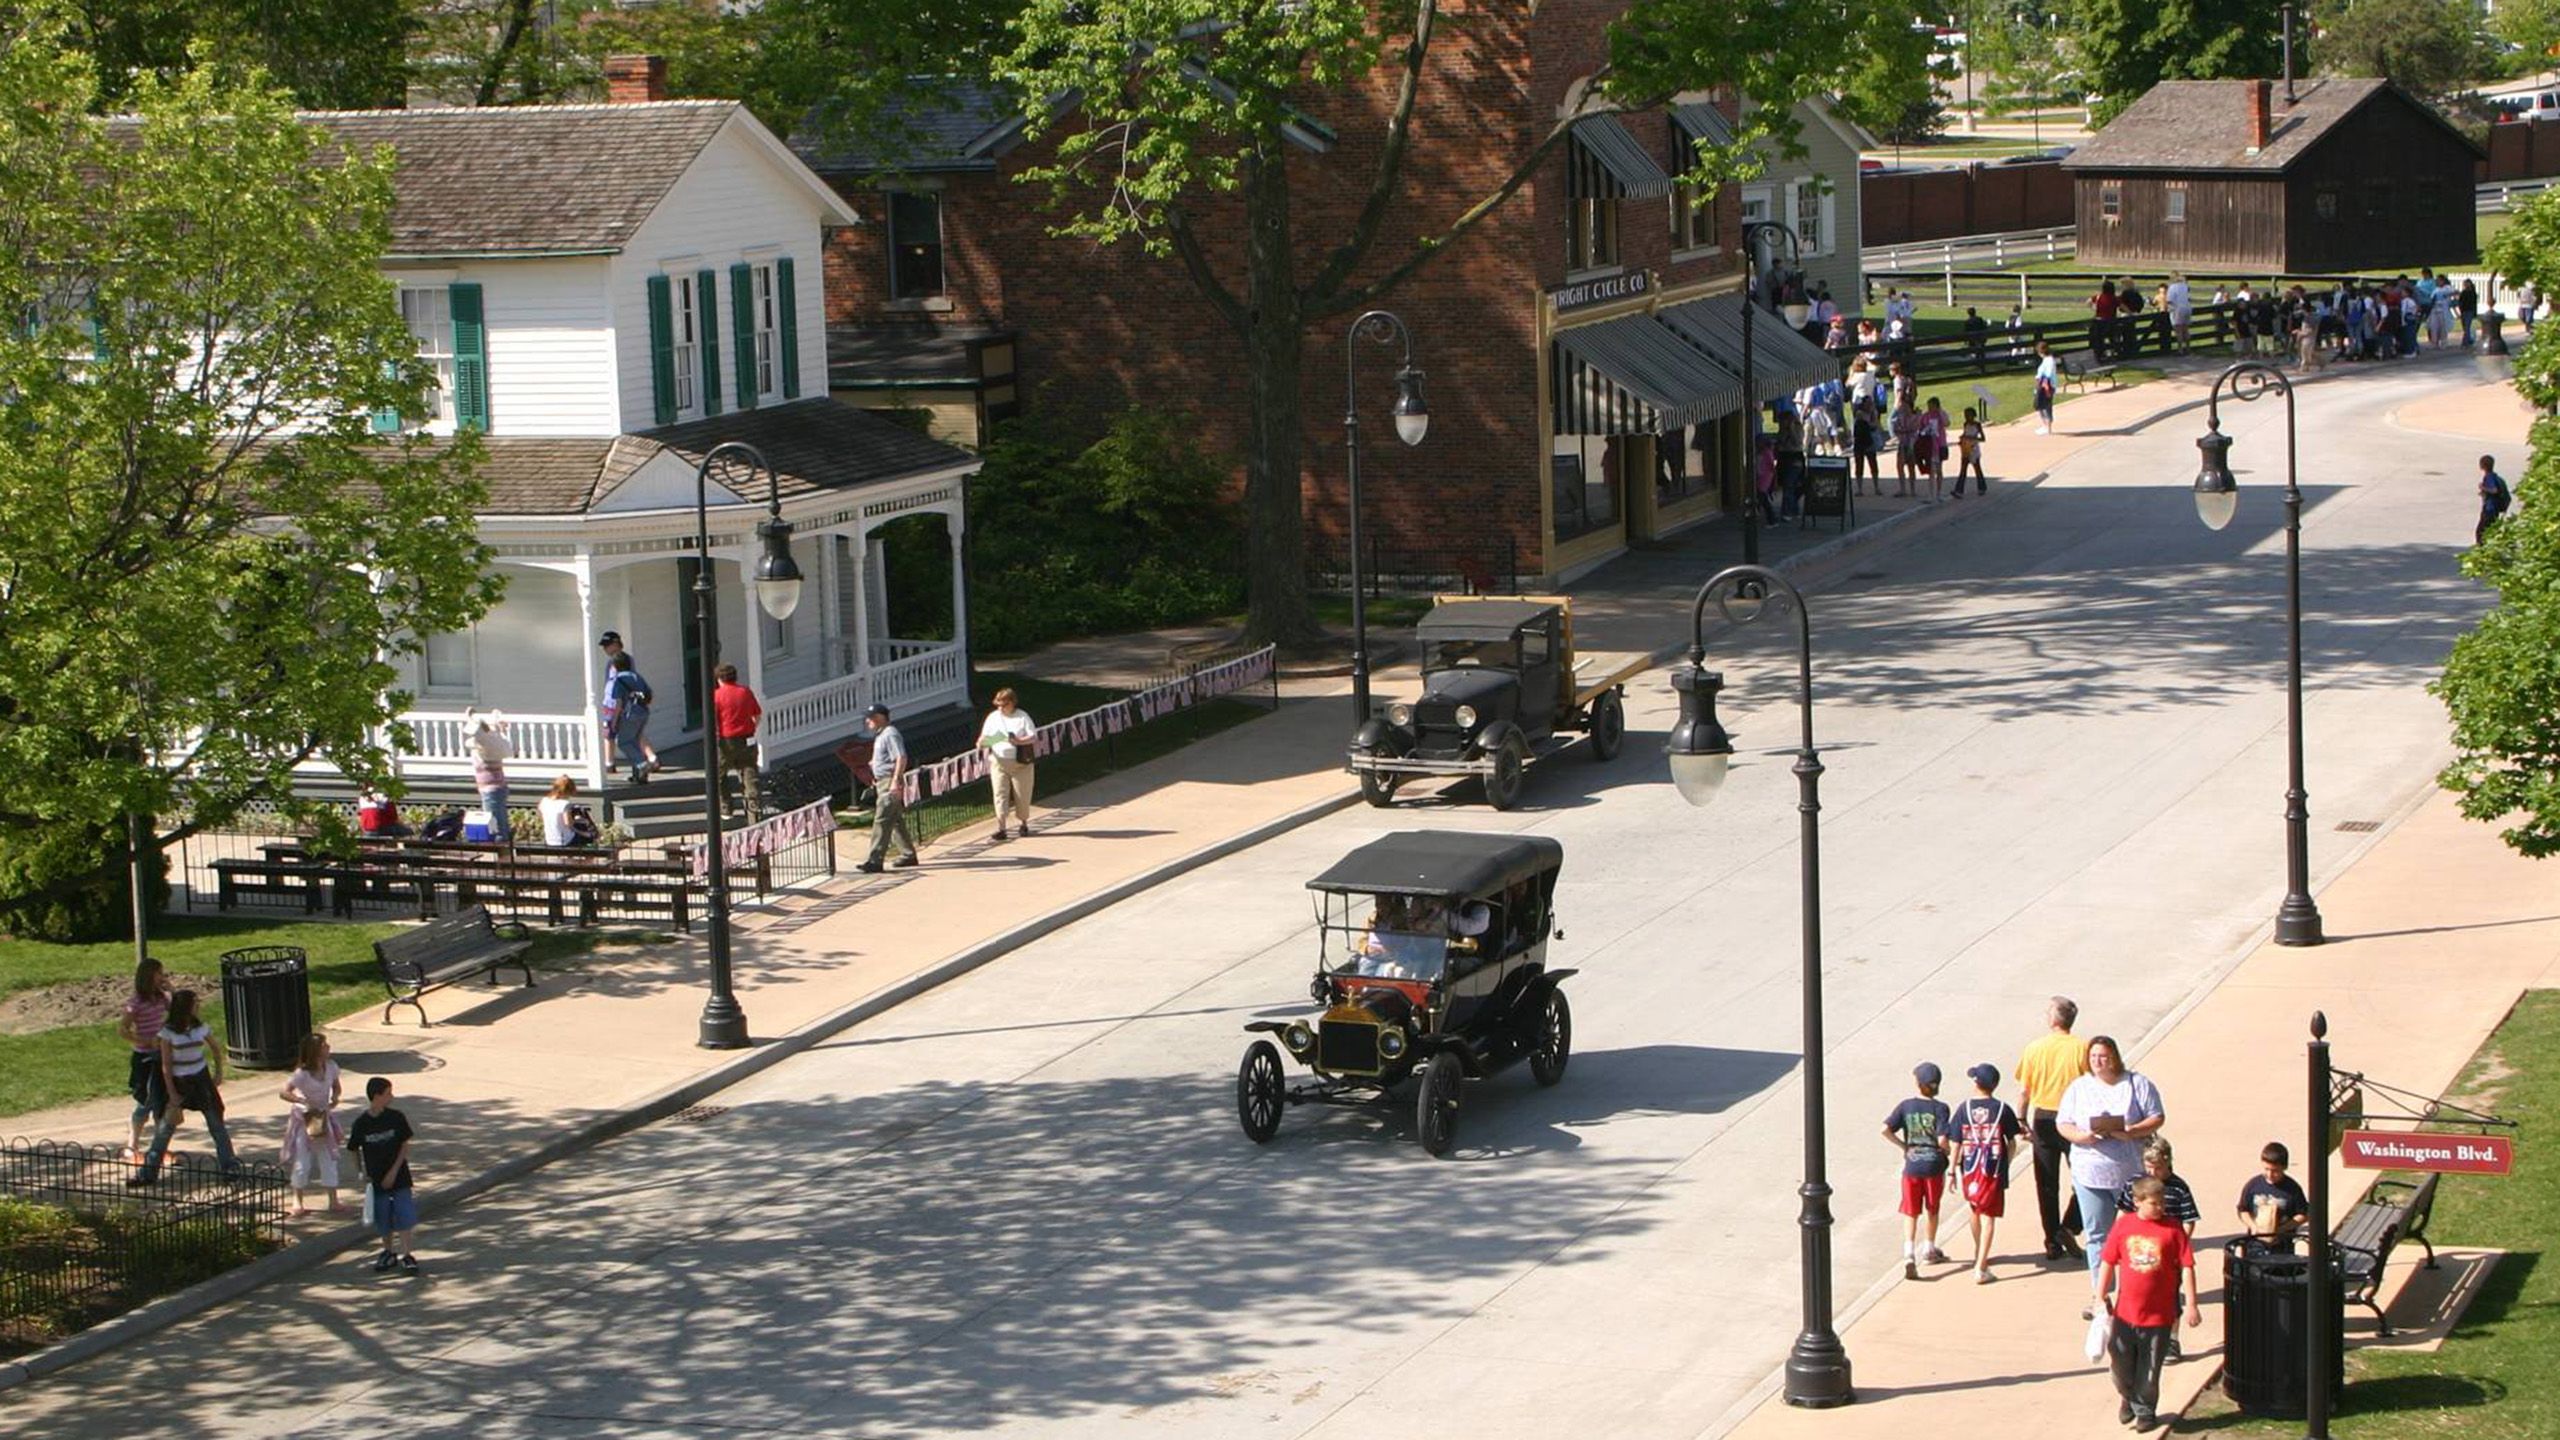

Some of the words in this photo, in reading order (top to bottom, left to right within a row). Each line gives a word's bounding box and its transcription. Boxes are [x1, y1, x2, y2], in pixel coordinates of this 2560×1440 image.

[1555, 284, 1590, 307] RIGHT
[2356, 1141, 2452, 1163] Washington
[2457, 1145, 2498, 1162] Blvd.
